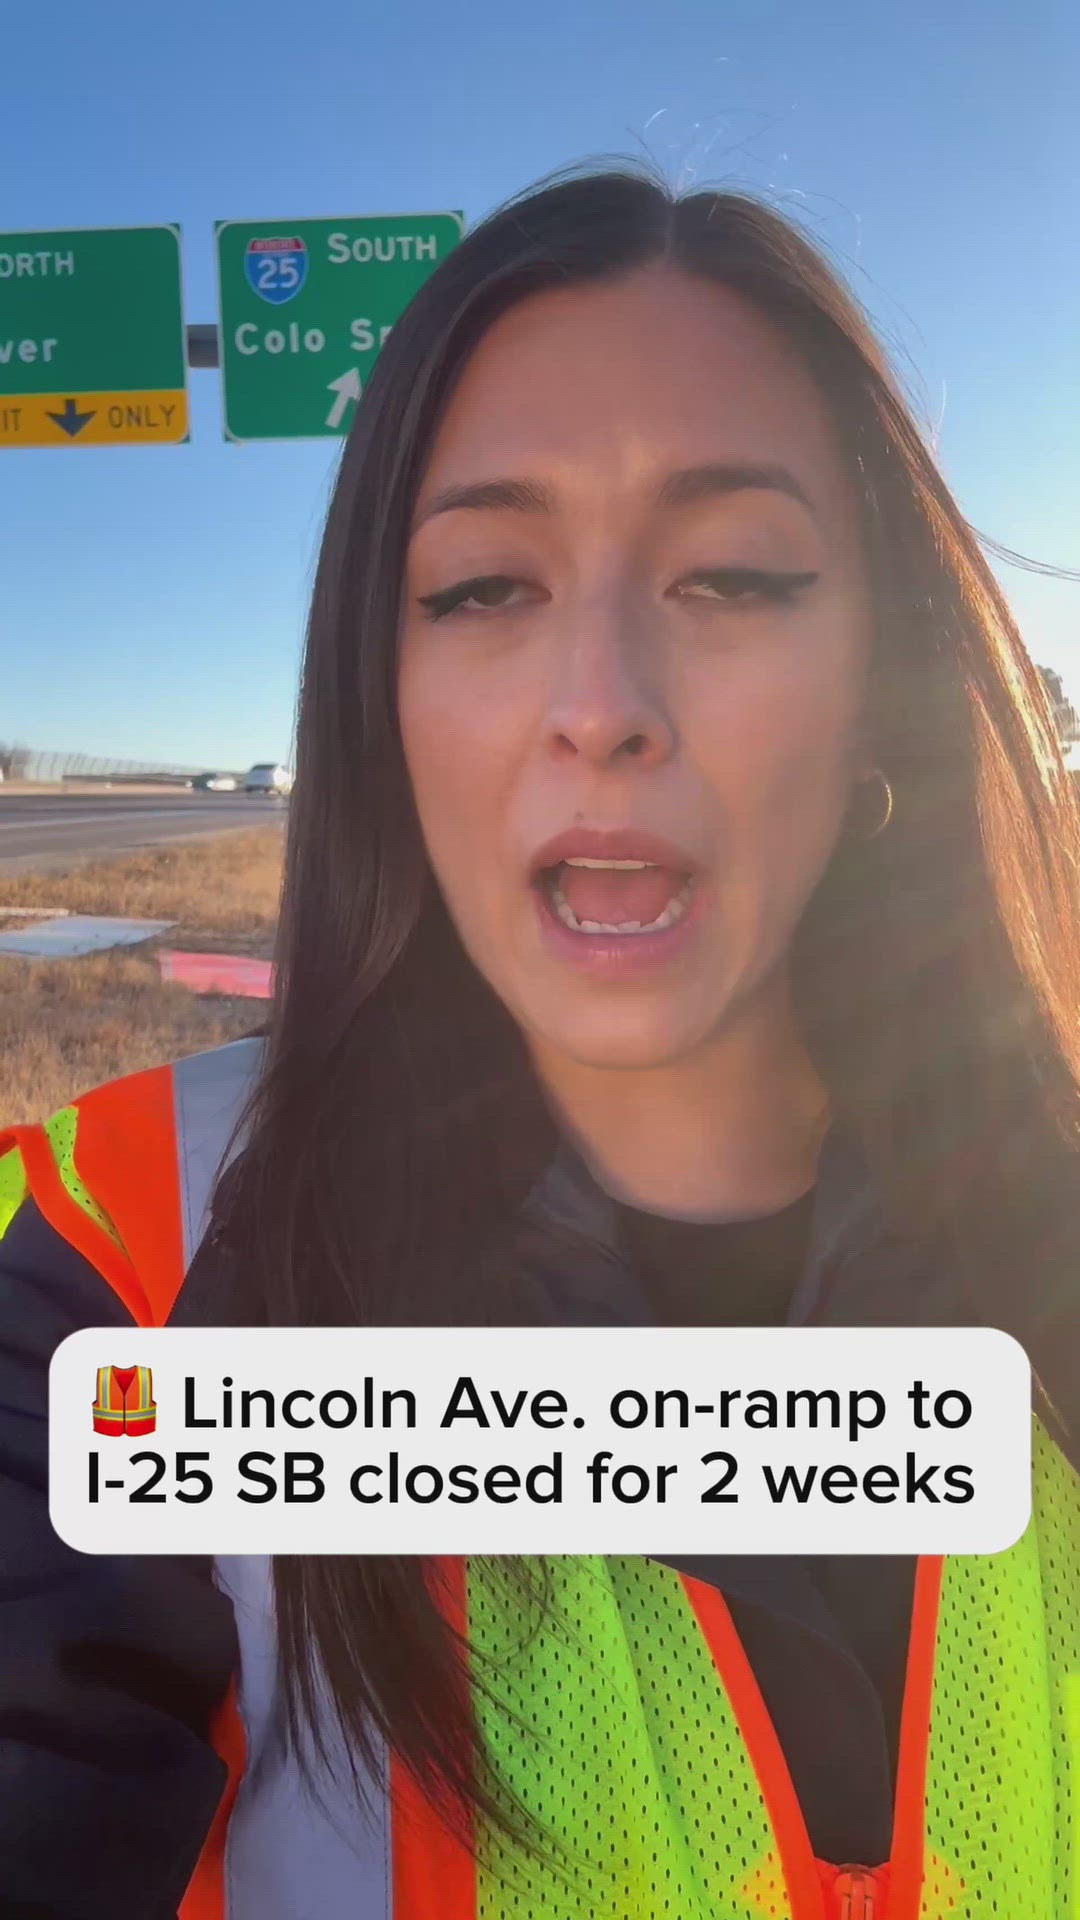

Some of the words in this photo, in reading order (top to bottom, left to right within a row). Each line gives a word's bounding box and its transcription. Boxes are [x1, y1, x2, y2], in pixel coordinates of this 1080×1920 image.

[327, 232, 437, 264] SOUTH
[257, 258, 300, 289] 25
[234, 321, 326, 355] Colo
[108, 403, 176, 429] ONLY
